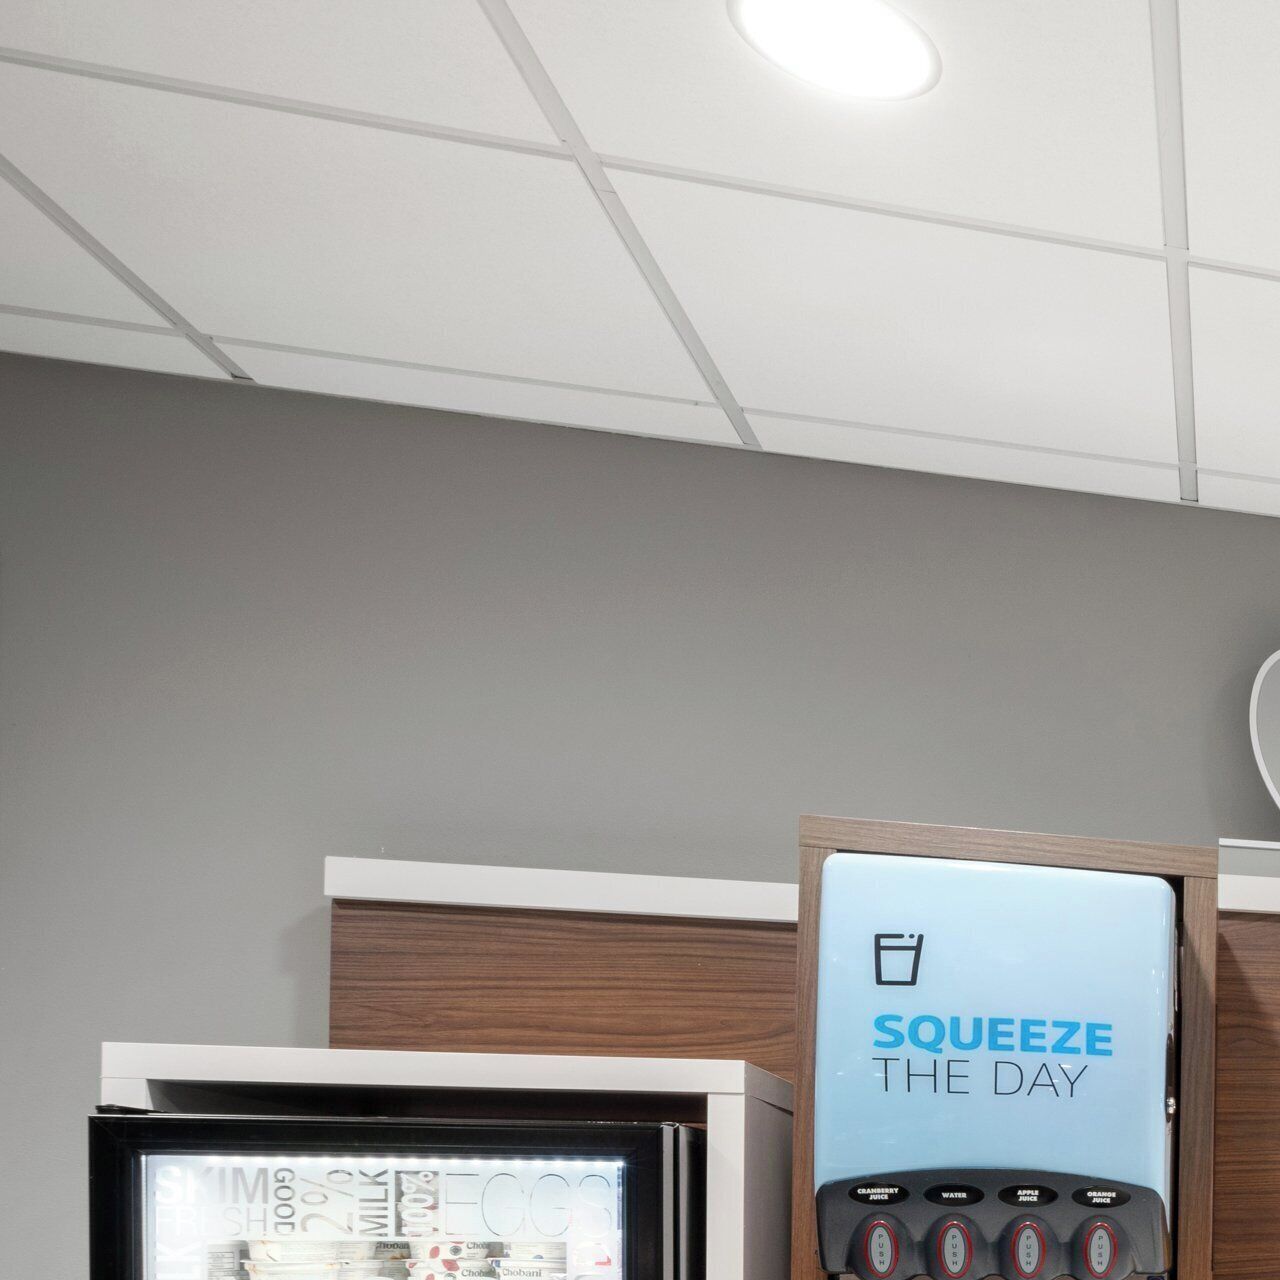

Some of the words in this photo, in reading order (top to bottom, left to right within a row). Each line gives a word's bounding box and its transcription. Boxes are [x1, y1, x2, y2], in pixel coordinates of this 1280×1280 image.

[873, 1014, 1113, 1056] SQUEEZE
[872, 1057, 970, 1096] THE
[993, 1060, 1088, 1098] DAY
[156, 1166, 269, 1204] SKIM
[273, 1167, 296, 1236] GOOD
[358, 1168, 389, 1238] MILK
[445, 1172, 612, 1238] EGGS
[857, 1187, 899, 1195] CRANBERRY
[501, 1268, 541, 1278] Chobani
